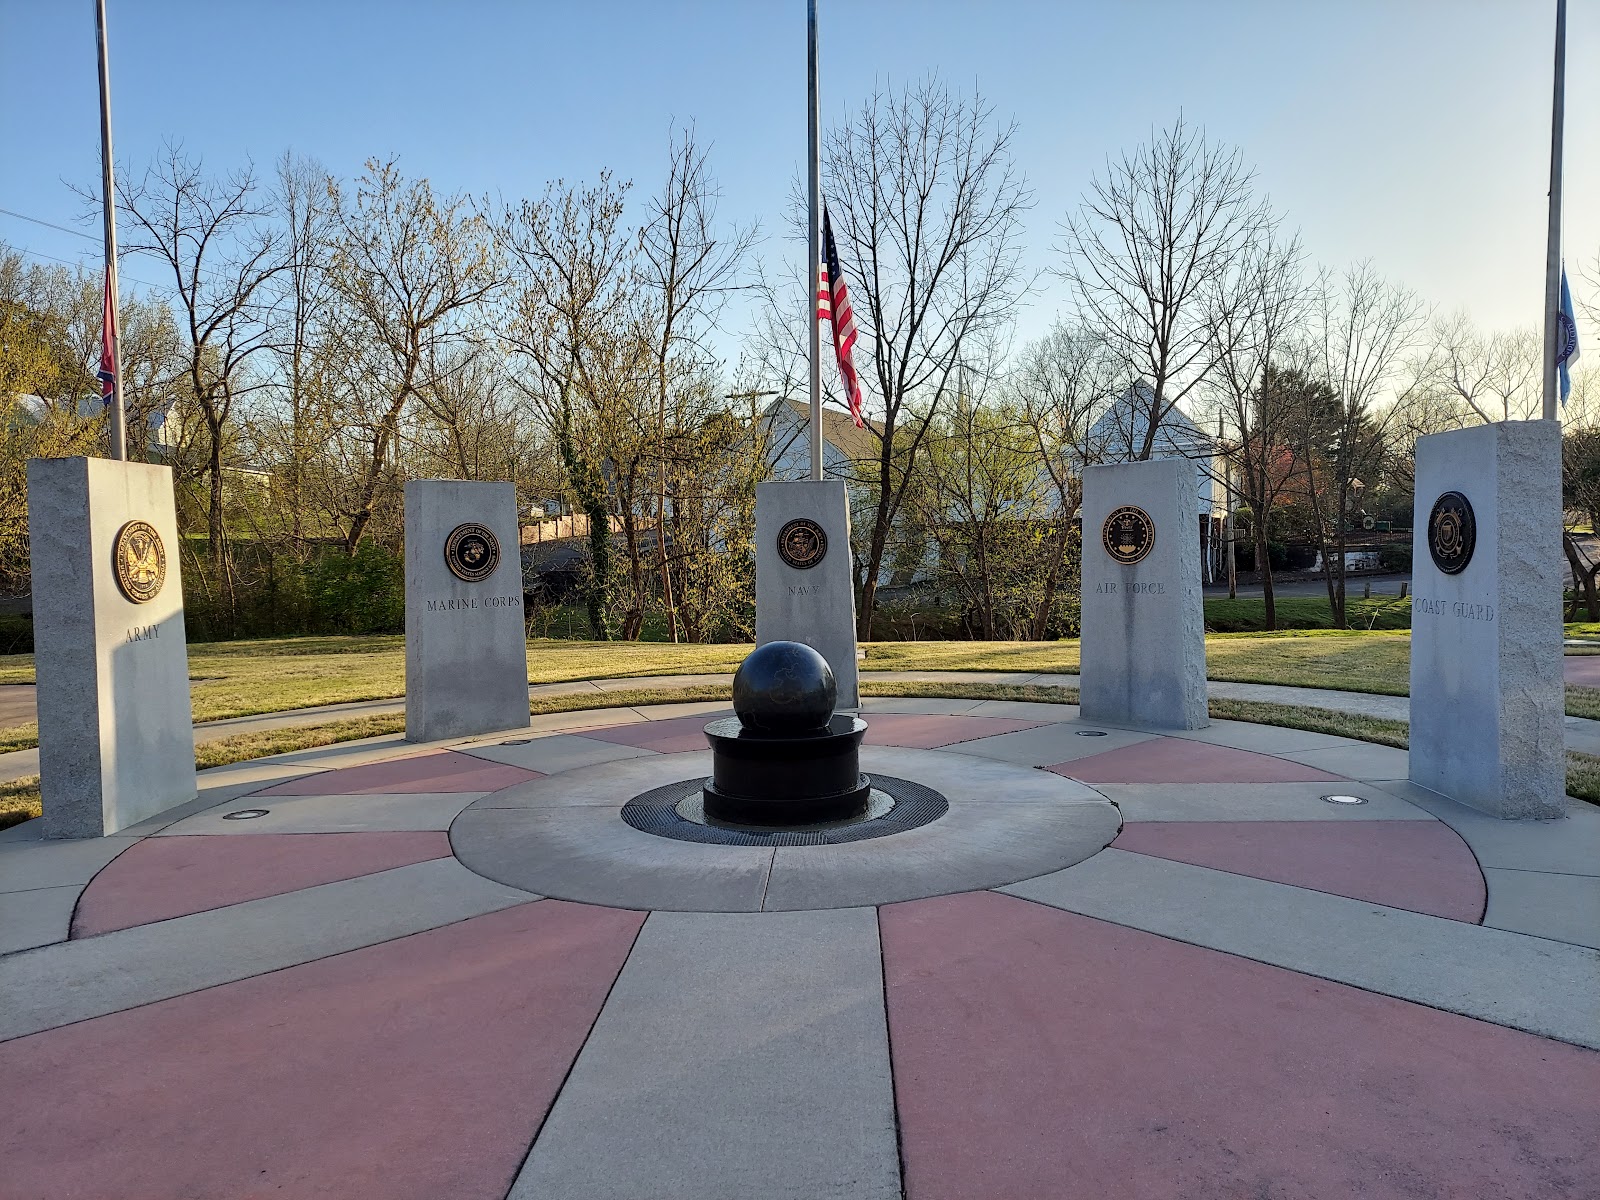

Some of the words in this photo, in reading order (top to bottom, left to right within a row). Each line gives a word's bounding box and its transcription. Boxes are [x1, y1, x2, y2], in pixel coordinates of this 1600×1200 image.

[451, 527, 476, 551] DEPARTMENT
[788, 585, 820, 596] NAVY
[1096, 582, 1118, 594] AIR
[1125, 582, 1166, 594] FORCE
[427, 598, 478, 612] MARINE
[484, 595, 520, 608] CORPS
[1414, 598, 1447, 616] COAST
[1452, 602, 1494, 622] GUARD
[125, 624, 160, 643] ARMY
